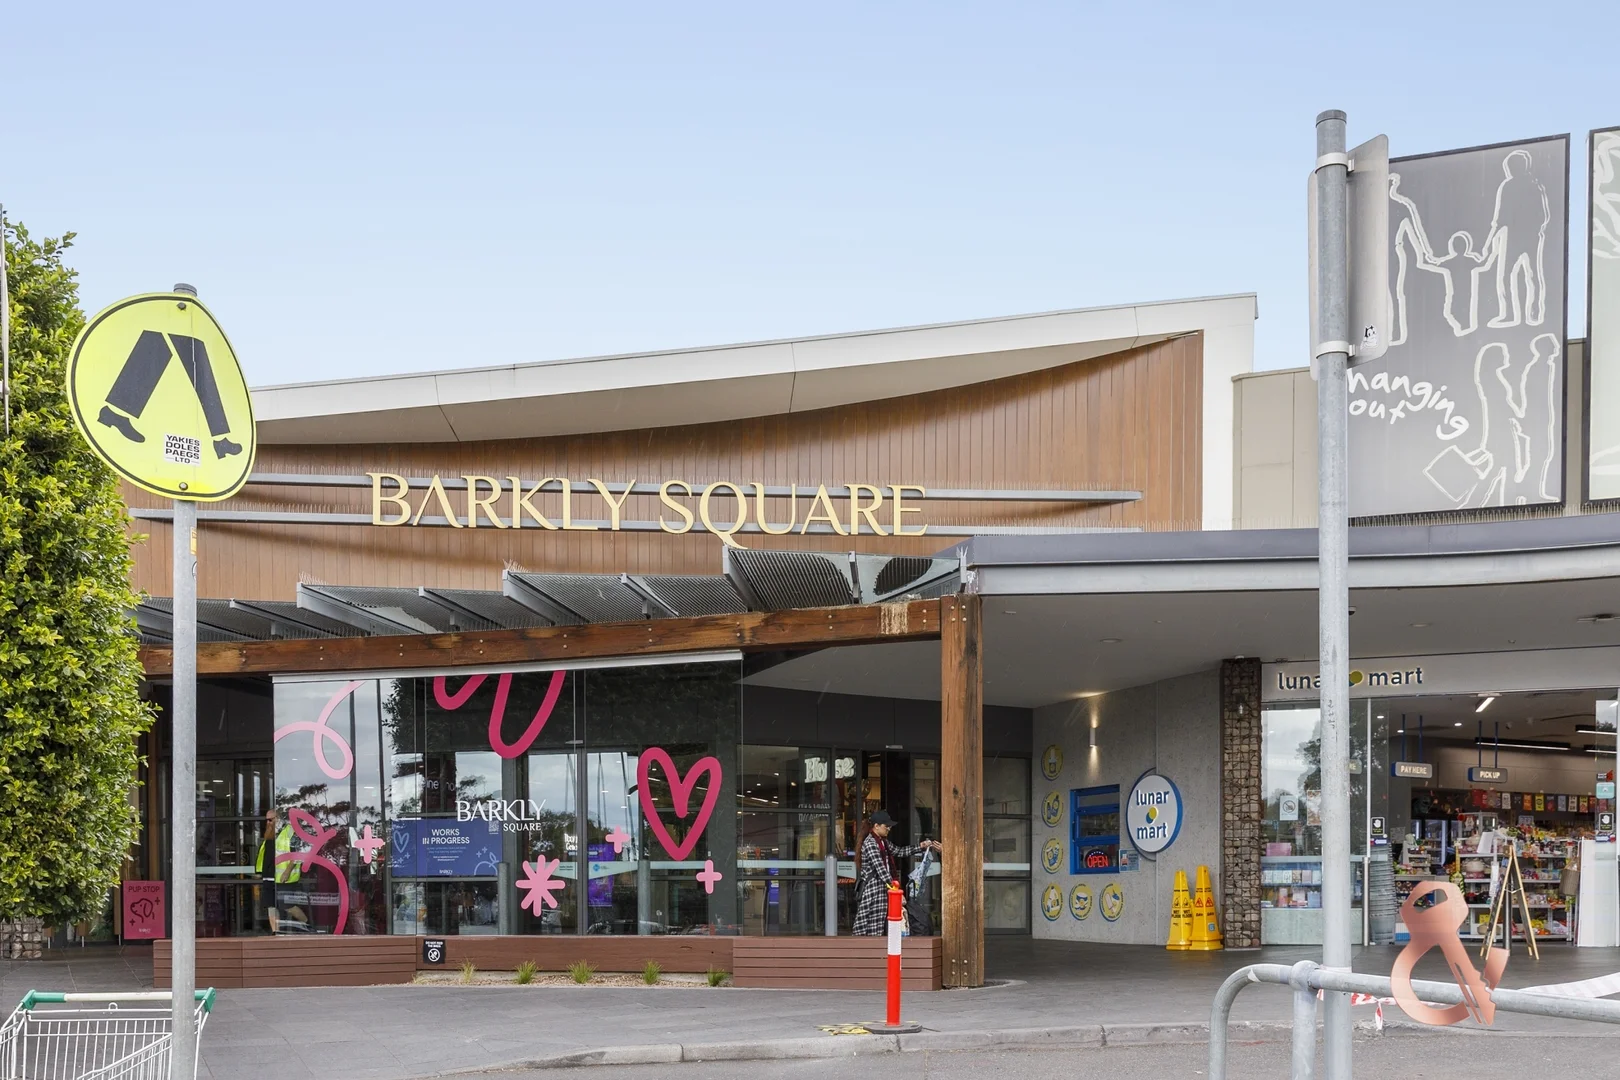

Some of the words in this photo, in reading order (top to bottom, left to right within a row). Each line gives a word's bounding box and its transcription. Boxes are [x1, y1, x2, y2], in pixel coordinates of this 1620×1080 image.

[1347, 368, 1469, 440] hanging
[1349, 399, 1405, 424] out
[166, 434, 200, 446] YAKIES
[165, 441, 200, 453] DOLES
[174, 456, 191, 464] LTD
[366, 472, 636, 531] BARKLY
[659, 480, 928, 549] SQUARE
[1278, 672, 1320, 690] luna
[1368, 668, 1423, 686] mart
[1136, 790, 1170, 806] lunar
[455, 799, 546, 822] BARKLY
[431, 828, 460, 836] WORKS
[503, 822, 542, 833] SQUARE
[1137, 822, 1168, 840] mart
[422, 837, 430, 845] IN
[430, 836, 470, 845] PROGRESS
[1087, 855, 1109, 868] OPEN
[128, 885, 141, 893] PUP
[142, 885, 160, 893] STOP
